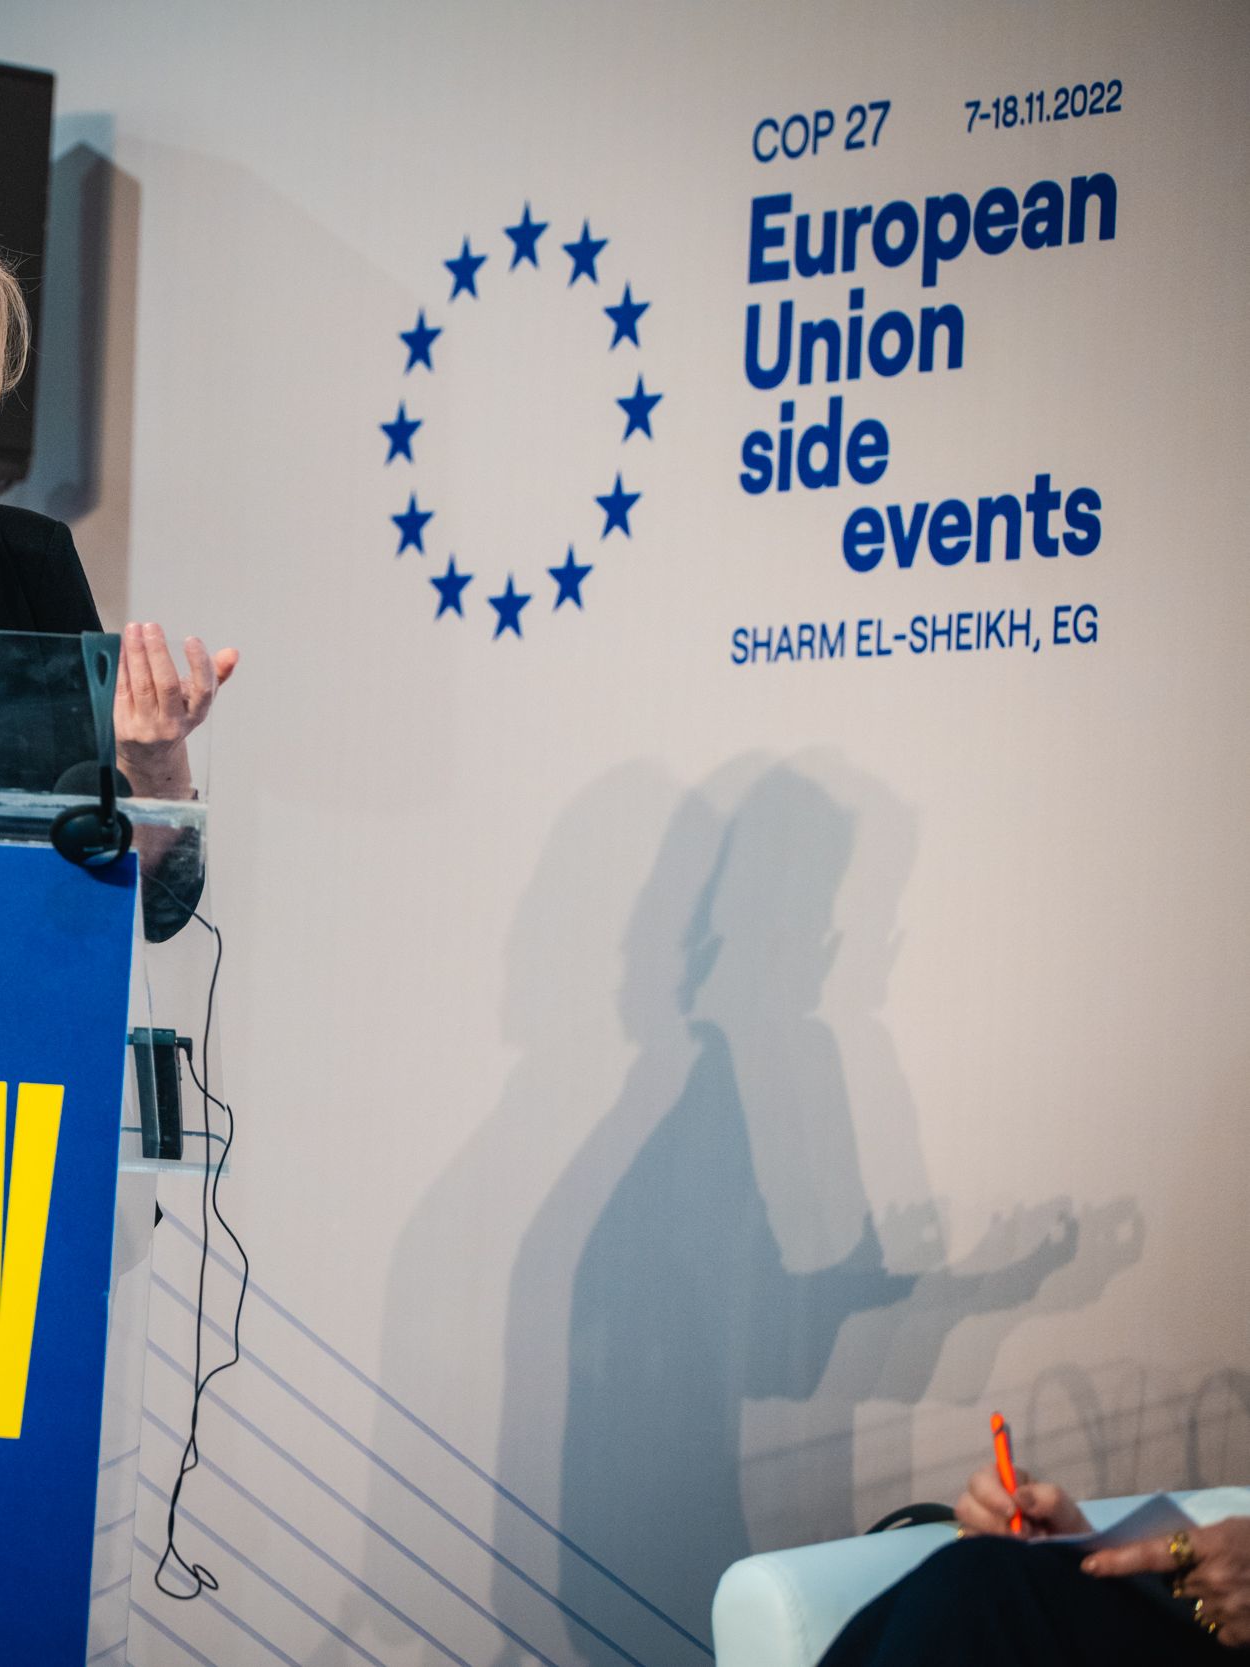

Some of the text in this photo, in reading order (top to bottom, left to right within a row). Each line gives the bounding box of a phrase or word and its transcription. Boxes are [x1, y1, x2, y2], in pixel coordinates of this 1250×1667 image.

[751, 98, 893, 164] COP 27
[963, 78, 1123, 133] 7-18.11.2022
[747, 171, 1120, 289] European
[743, 286, 965, 391] Union
[739, 394, 891, 496] side
[842, 472, 1103, 573] events
[731, 603, 1099, 665] SHARM EL-SHEIKH, EG
